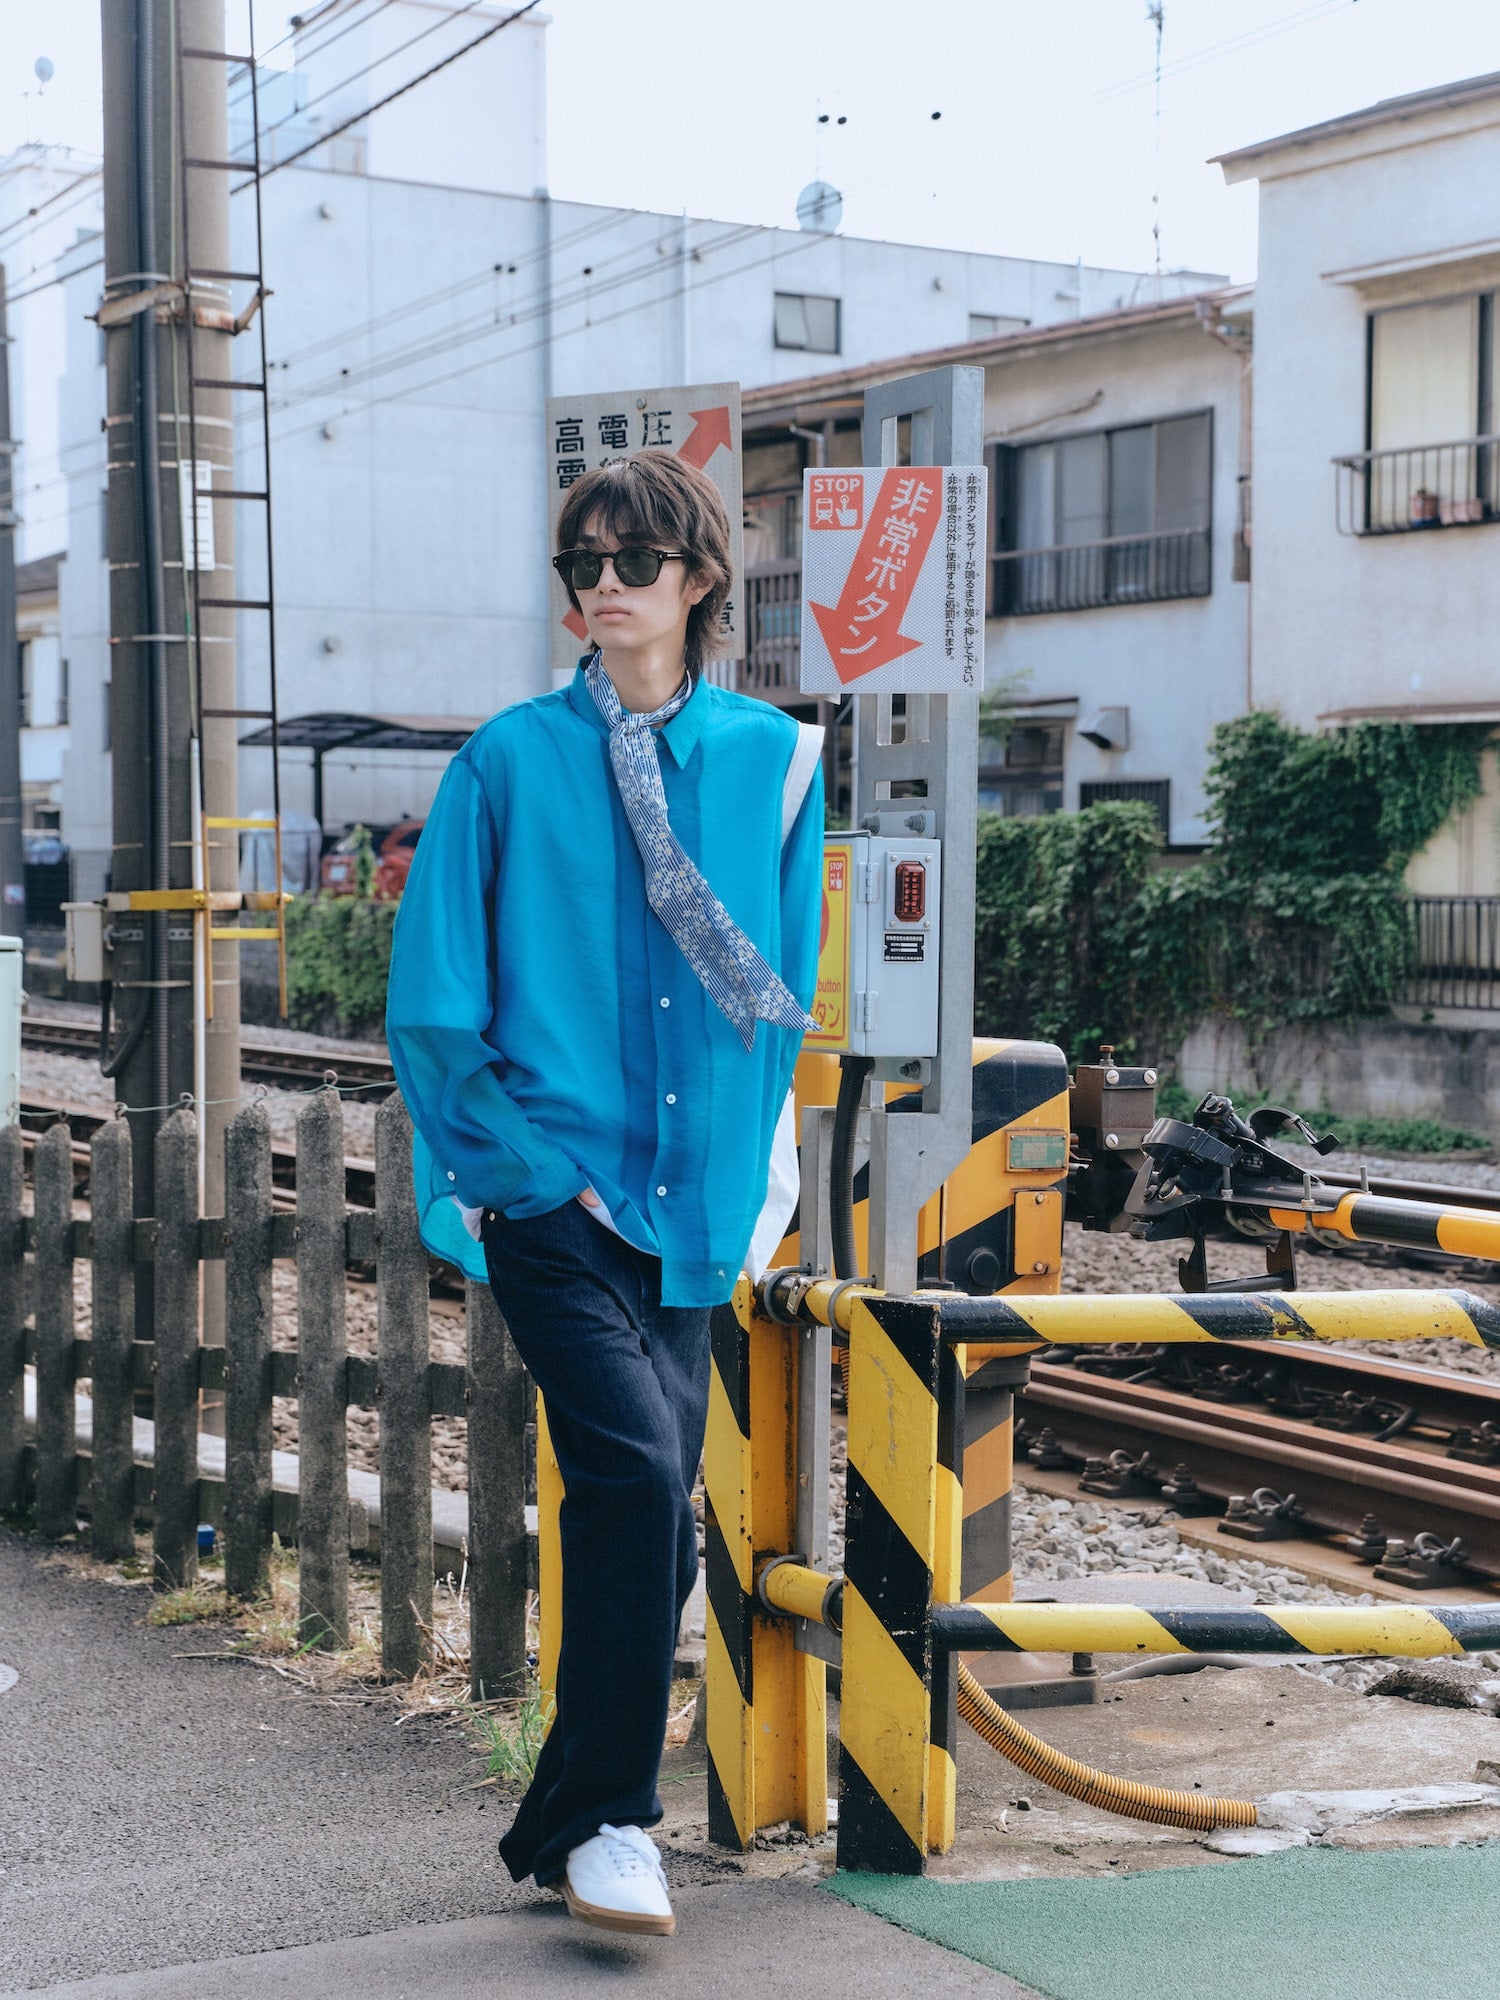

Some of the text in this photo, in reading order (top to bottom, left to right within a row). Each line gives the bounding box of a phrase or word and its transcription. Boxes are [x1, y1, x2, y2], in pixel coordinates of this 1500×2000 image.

[555, 410, 672, 454] 高電圧
[813, 477, 861, 493] STOP
[839, 477, 934, 656] 非常ボタン
[829, 861, 843, 871] STOP
[817, 978, 842, 993] button
[810, 999, 841, 1028] タン
